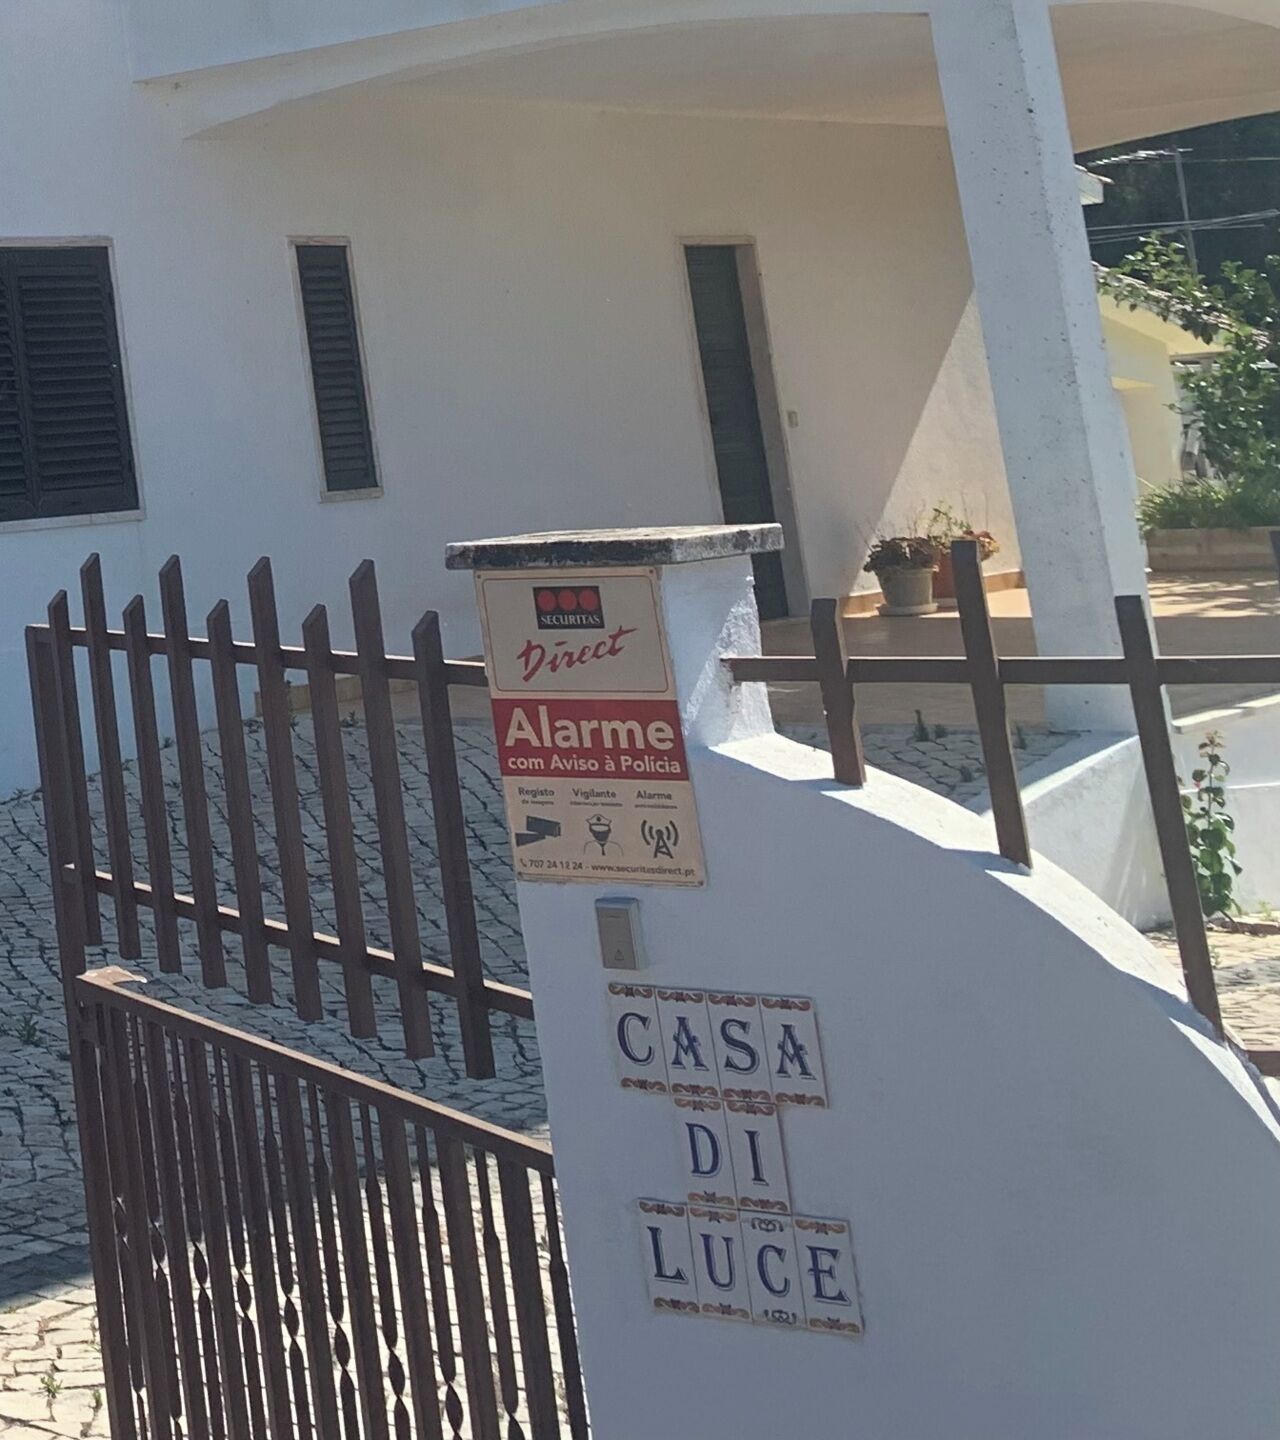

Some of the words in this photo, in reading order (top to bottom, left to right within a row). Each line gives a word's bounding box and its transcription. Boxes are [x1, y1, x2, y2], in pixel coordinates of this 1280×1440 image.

[540, 614, 601, 625] SECURITAS
[517, 625, 638, 682] Direct
[505, 705, 675, 750] Alarme
[508, 756, 544, 770] com
[550, 754, 599, 772] Aviso
[604, 754, 616, 772] à
[621, 755, 681, 774] Polícia
[518, 787, 555, 799] Registo
[572, 788, 617, 800] Vigilante
[635, 790, 672, 801] Alarme
[529, 858, 544, 869] 707
[546, 859, 558, 869] 24
[590, 864, 696, 878] www.securitasdirect.pt
[616, 1012, 817, 1081] CASA
[684, 1121, 769, 1187] DI
[646, 1225, 852, 1306] LUCE
